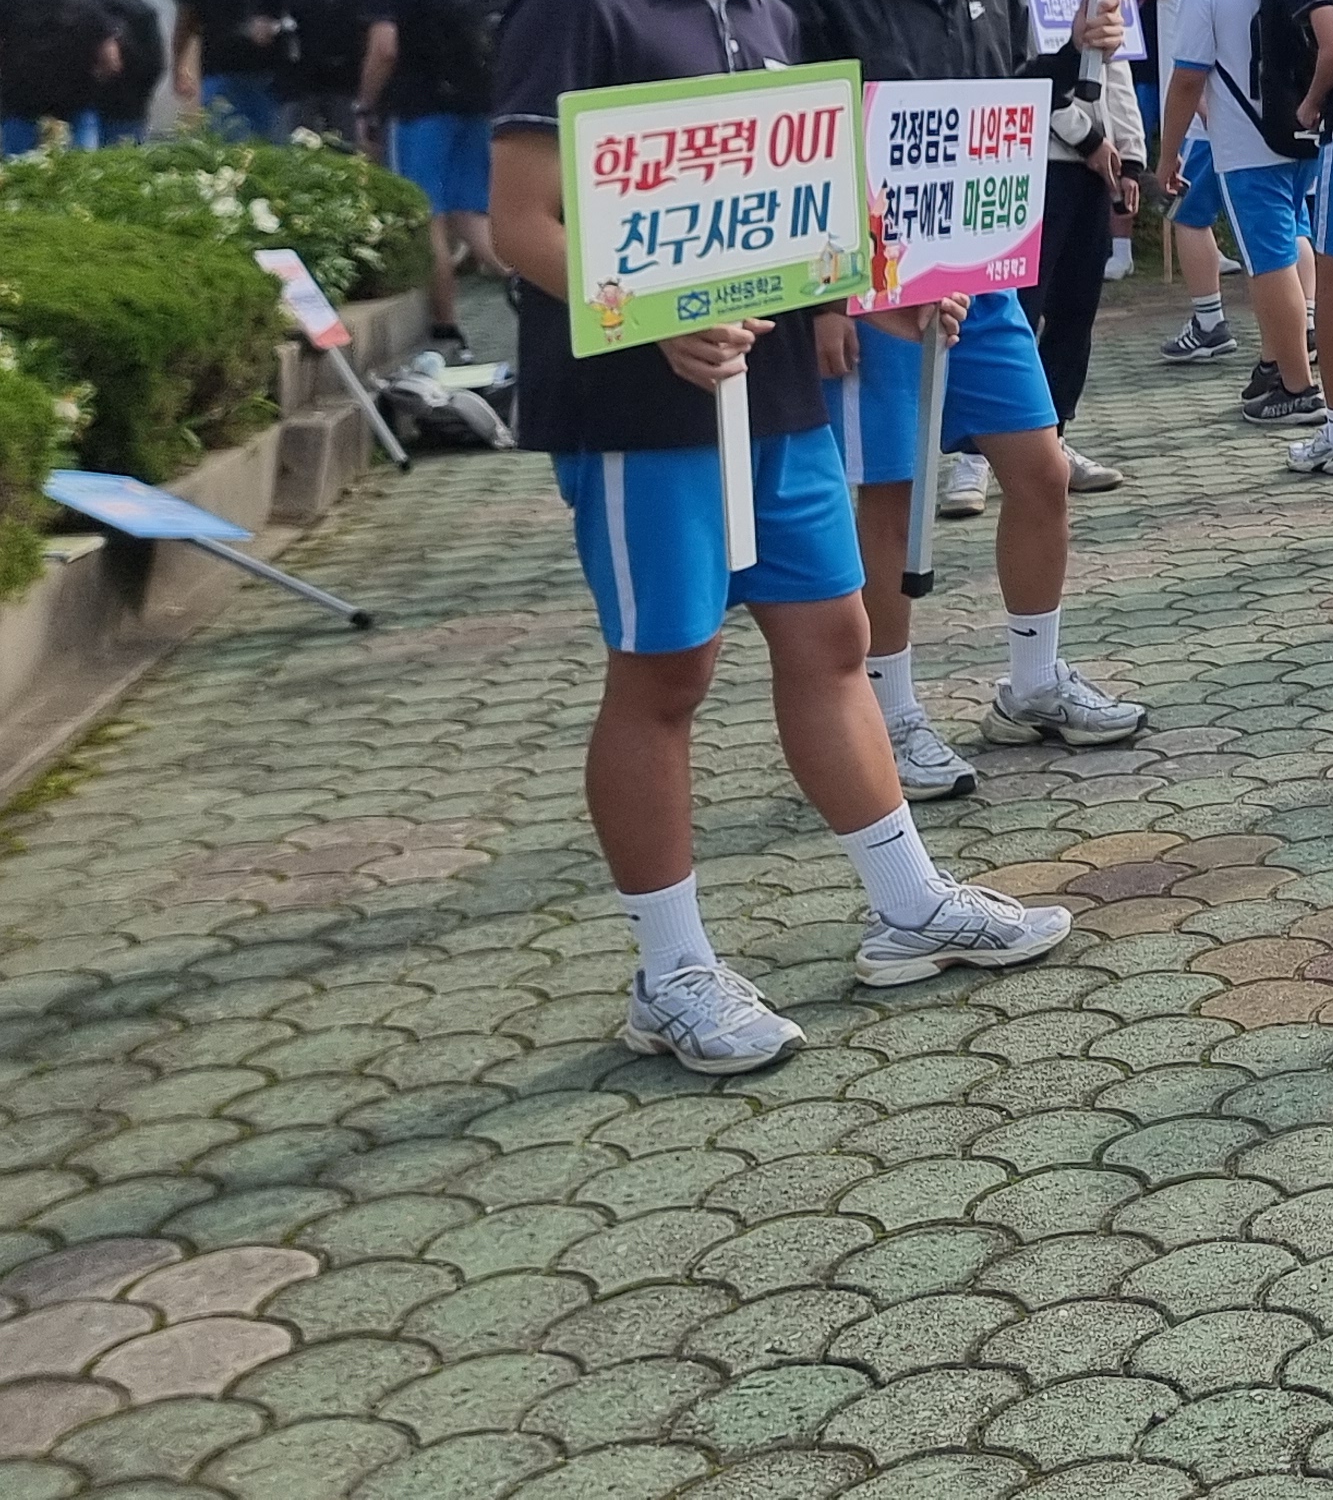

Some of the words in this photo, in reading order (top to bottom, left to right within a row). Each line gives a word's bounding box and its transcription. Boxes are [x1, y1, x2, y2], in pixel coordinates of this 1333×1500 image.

[593, 118, 757, 196] 학교폭력
[769, 106, 844, 168] OUT
[889, 107, 960, 166] 감정담은
[967, 105, 1034, 160] 나의주먹
[615, 189, 781, 275] 친구사랑
[789, 181, 832, 237] IN
[883, 180, 955, 241] 친구에겐
[962, 174, 1031, 231] 마음의병
[715, 275, 784, 304] 사천중학교
[985, 257, 1027, 281] 사천중학교
